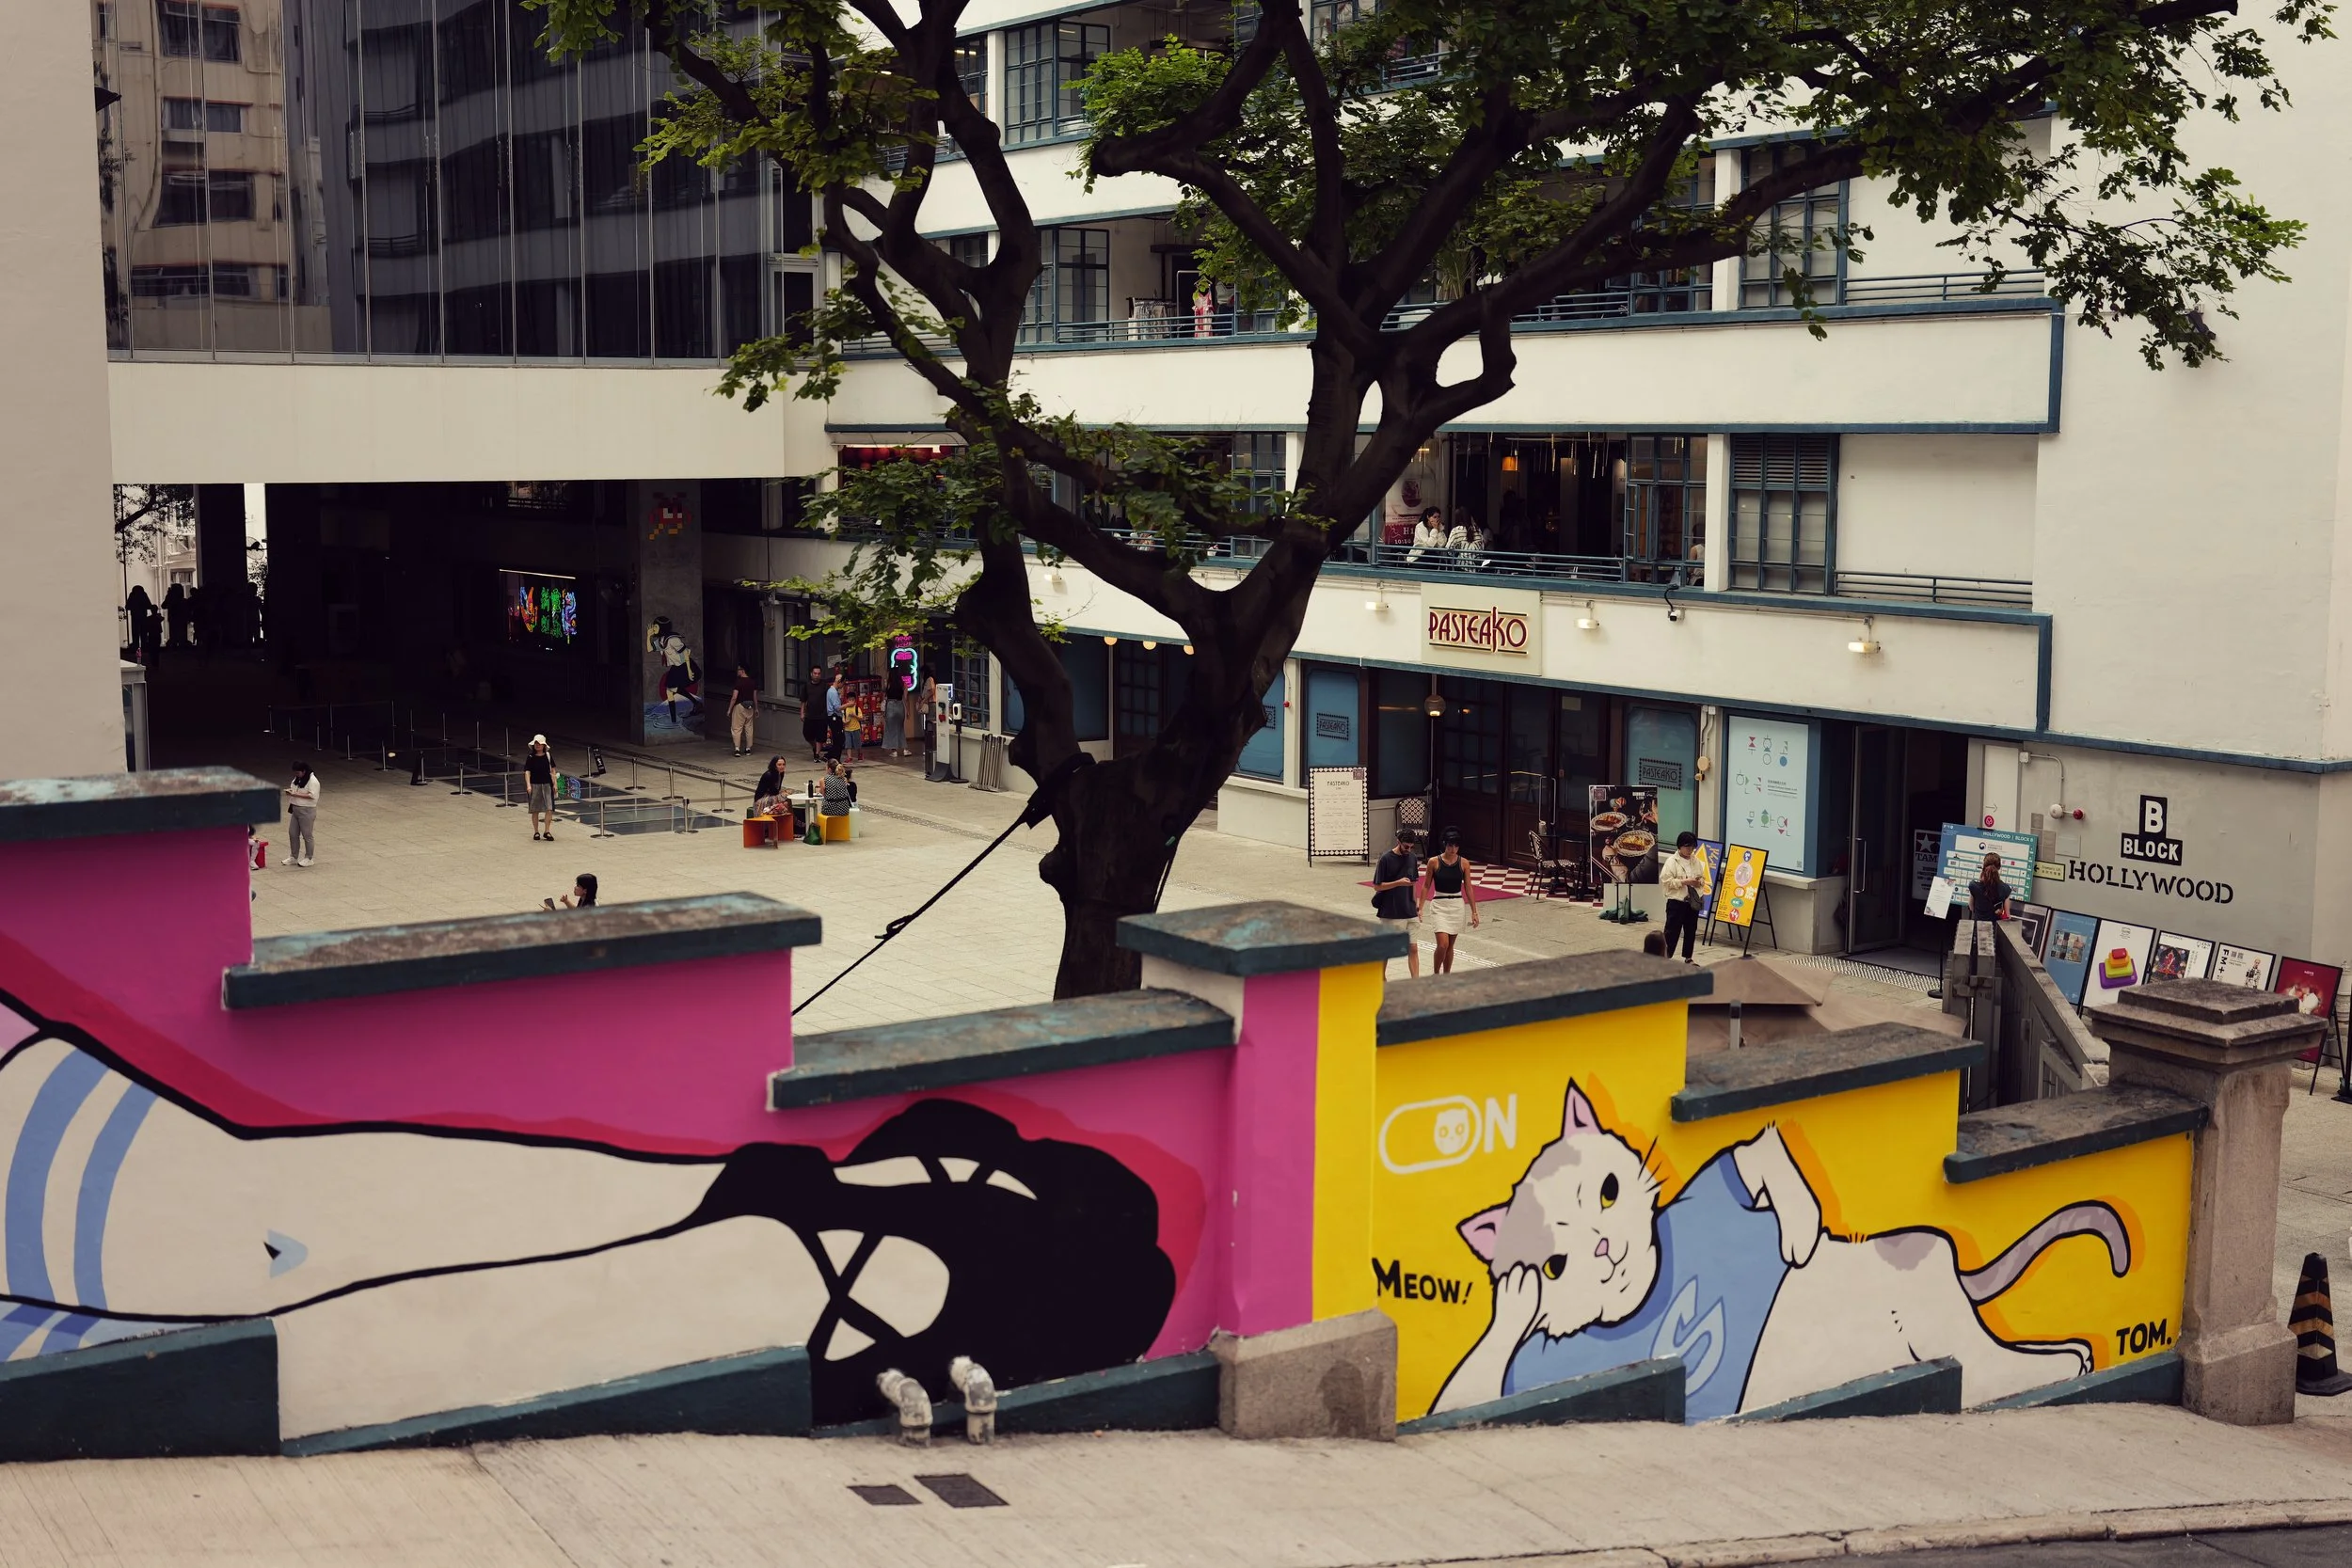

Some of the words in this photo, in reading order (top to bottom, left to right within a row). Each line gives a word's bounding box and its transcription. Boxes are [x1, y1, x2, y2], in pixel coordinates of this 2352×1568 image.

[1428, 606, 1528, 653] PASTEAKO
[1643, 766, 1677, 782] PASTEAKO
[2144, 800, 2164, 833] B
[1982, 832, 2011, 840] HOLLYWOOD
[2122, 837, 2180, 862] BLOCK
[1915, 852, 1938, 863] TAM
[2069, 860, 2233, 904] HOLLYWOOD
[2116, 1318, 2172, 1355] TOM.
